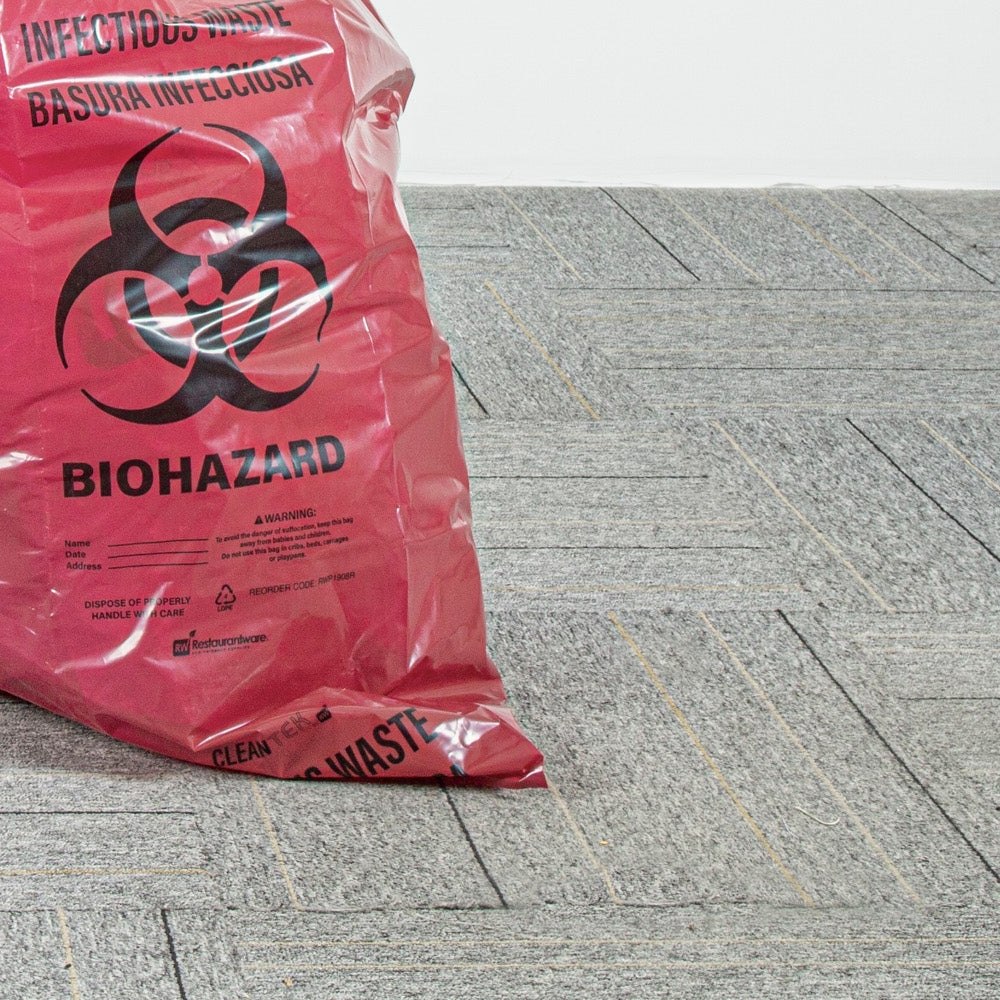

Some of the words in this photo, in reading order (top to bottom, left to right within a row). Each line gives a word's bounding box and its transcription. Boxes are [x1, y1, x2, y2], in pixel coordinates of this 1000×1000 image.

[20, 9, 198, 63] INFECTIOUS
[201, 0, 292, 39] WASTE
[27, 80, 151, 128] BASURA
[149, 54, 314, 107] INFECCIOSA
[62, 435, 346, 497] BIOHAZARD
[264, 508, 316, 523] WARNING:
[223, 534, 240, 542] avoid
[251, 528, 273, 539] danger
[64, 540, 91, 548] Name
[65, 550, 86, 558] Date
[255, 547, 267, 555] this
[268, 546, 280, 555] bag
[66, 562, 102, 571] Address
[249, 584, 291, 596] REORDER
[84, 599, 126, 609] DISPOSE
[128, 598, 141, 607] OF
[91, 610, 132, 620] HANDLE
[160, 608, 185, 617] CARE
[325, 707, 438, 778] WASTE
